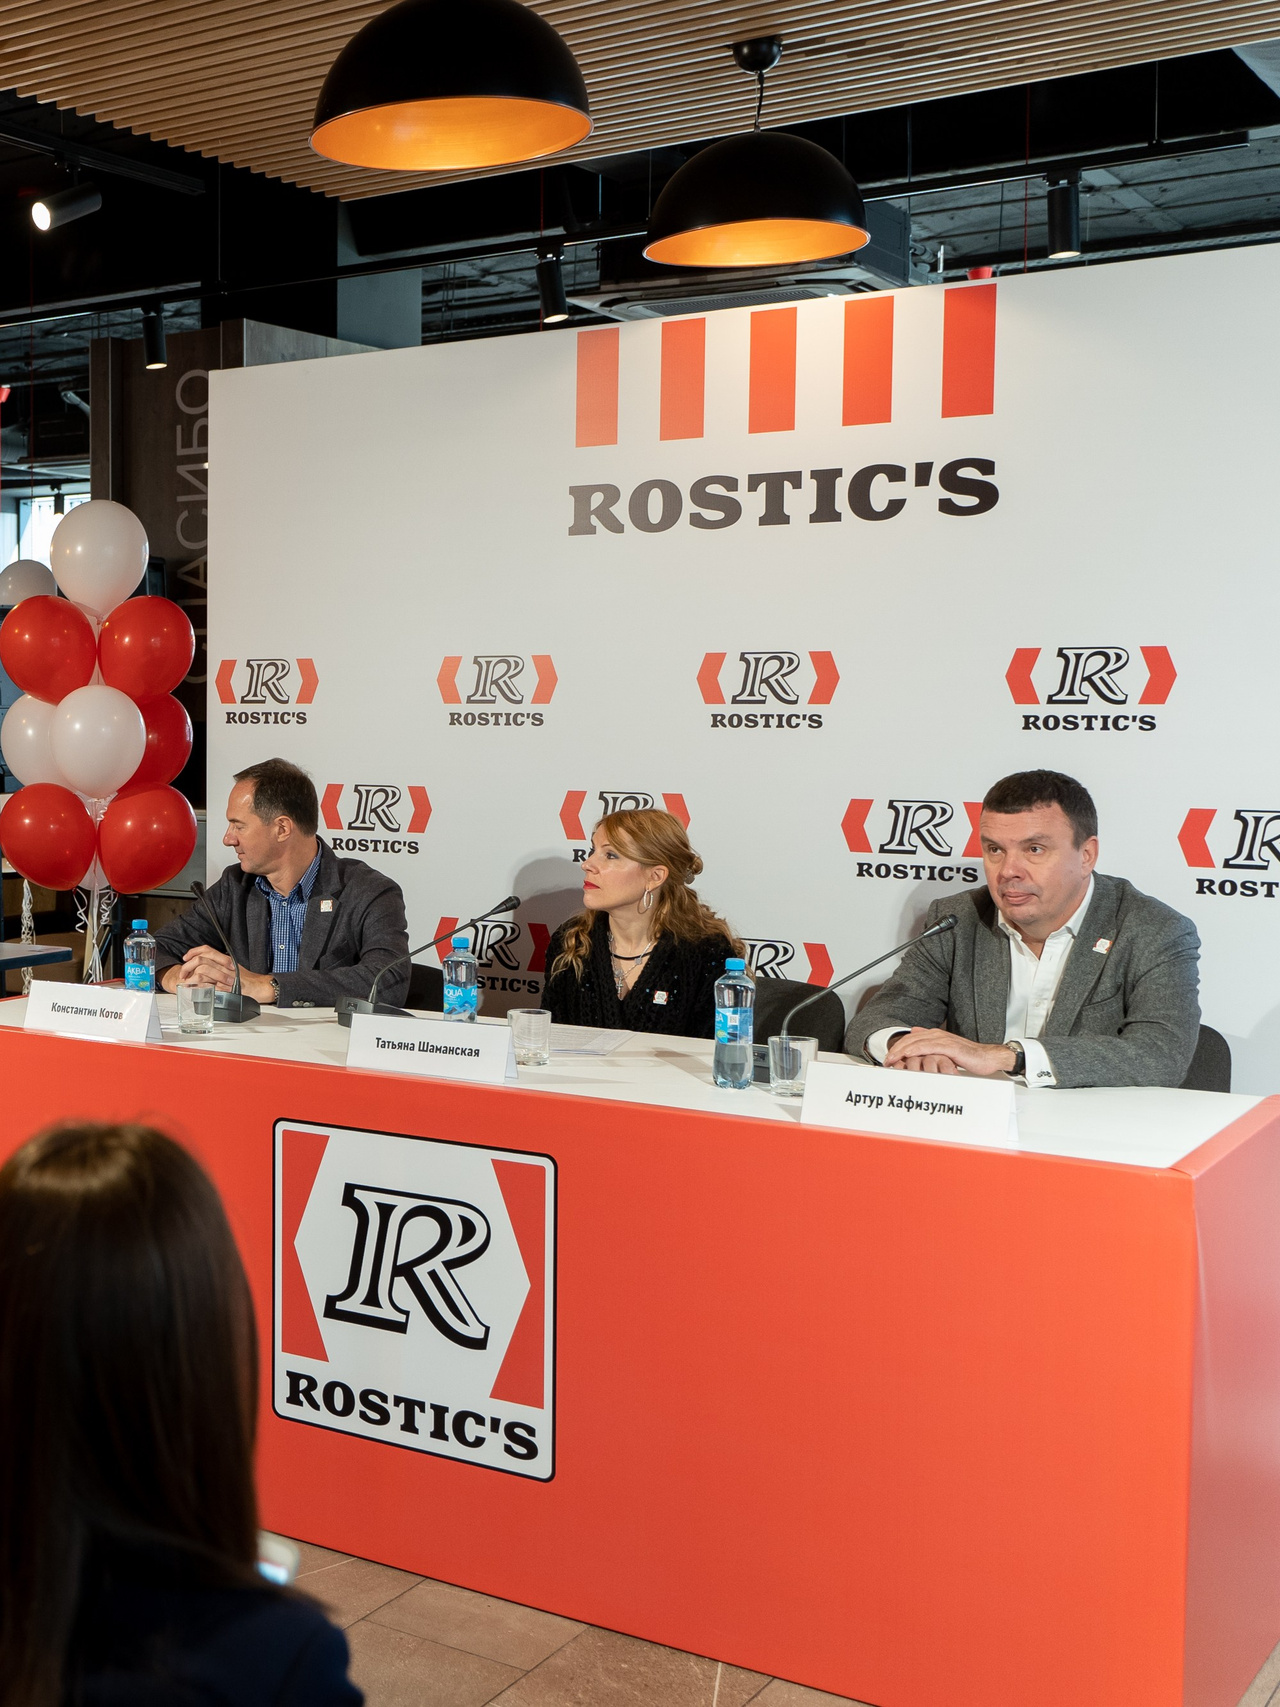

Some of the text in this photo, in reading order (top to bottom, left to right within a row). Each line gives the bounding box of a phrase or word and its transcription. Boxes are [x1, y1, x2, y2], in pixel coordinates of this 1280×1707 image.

[568, 457, 1000, 536] ROSTIC'S
[225, 711, 307, 725] ROSTIC'S
[449, 712, 544, 727] ROSTIC'S
[710, 713, 823, 729] ROSTIC'S
[1022, 714, 1157, 731] ROSTIC'S
[332, 838, 420, 855] ROSTIC'S
[857, 862, 979, 883] ROSTIC'S
[1195, 878, 1280, 898] ROST
[477, 975, 540, 994] STIC'S
[51, 1002, 123, 1020] Константин Котов
[376, 1037, 480, 1058] Татьяна Шаманская
[845, 1090, 963, 1115] Артур Хафизулин
[323, 1182, 491, 1351] R
[286, 1370, 539, 1461] ROSTIC'S
